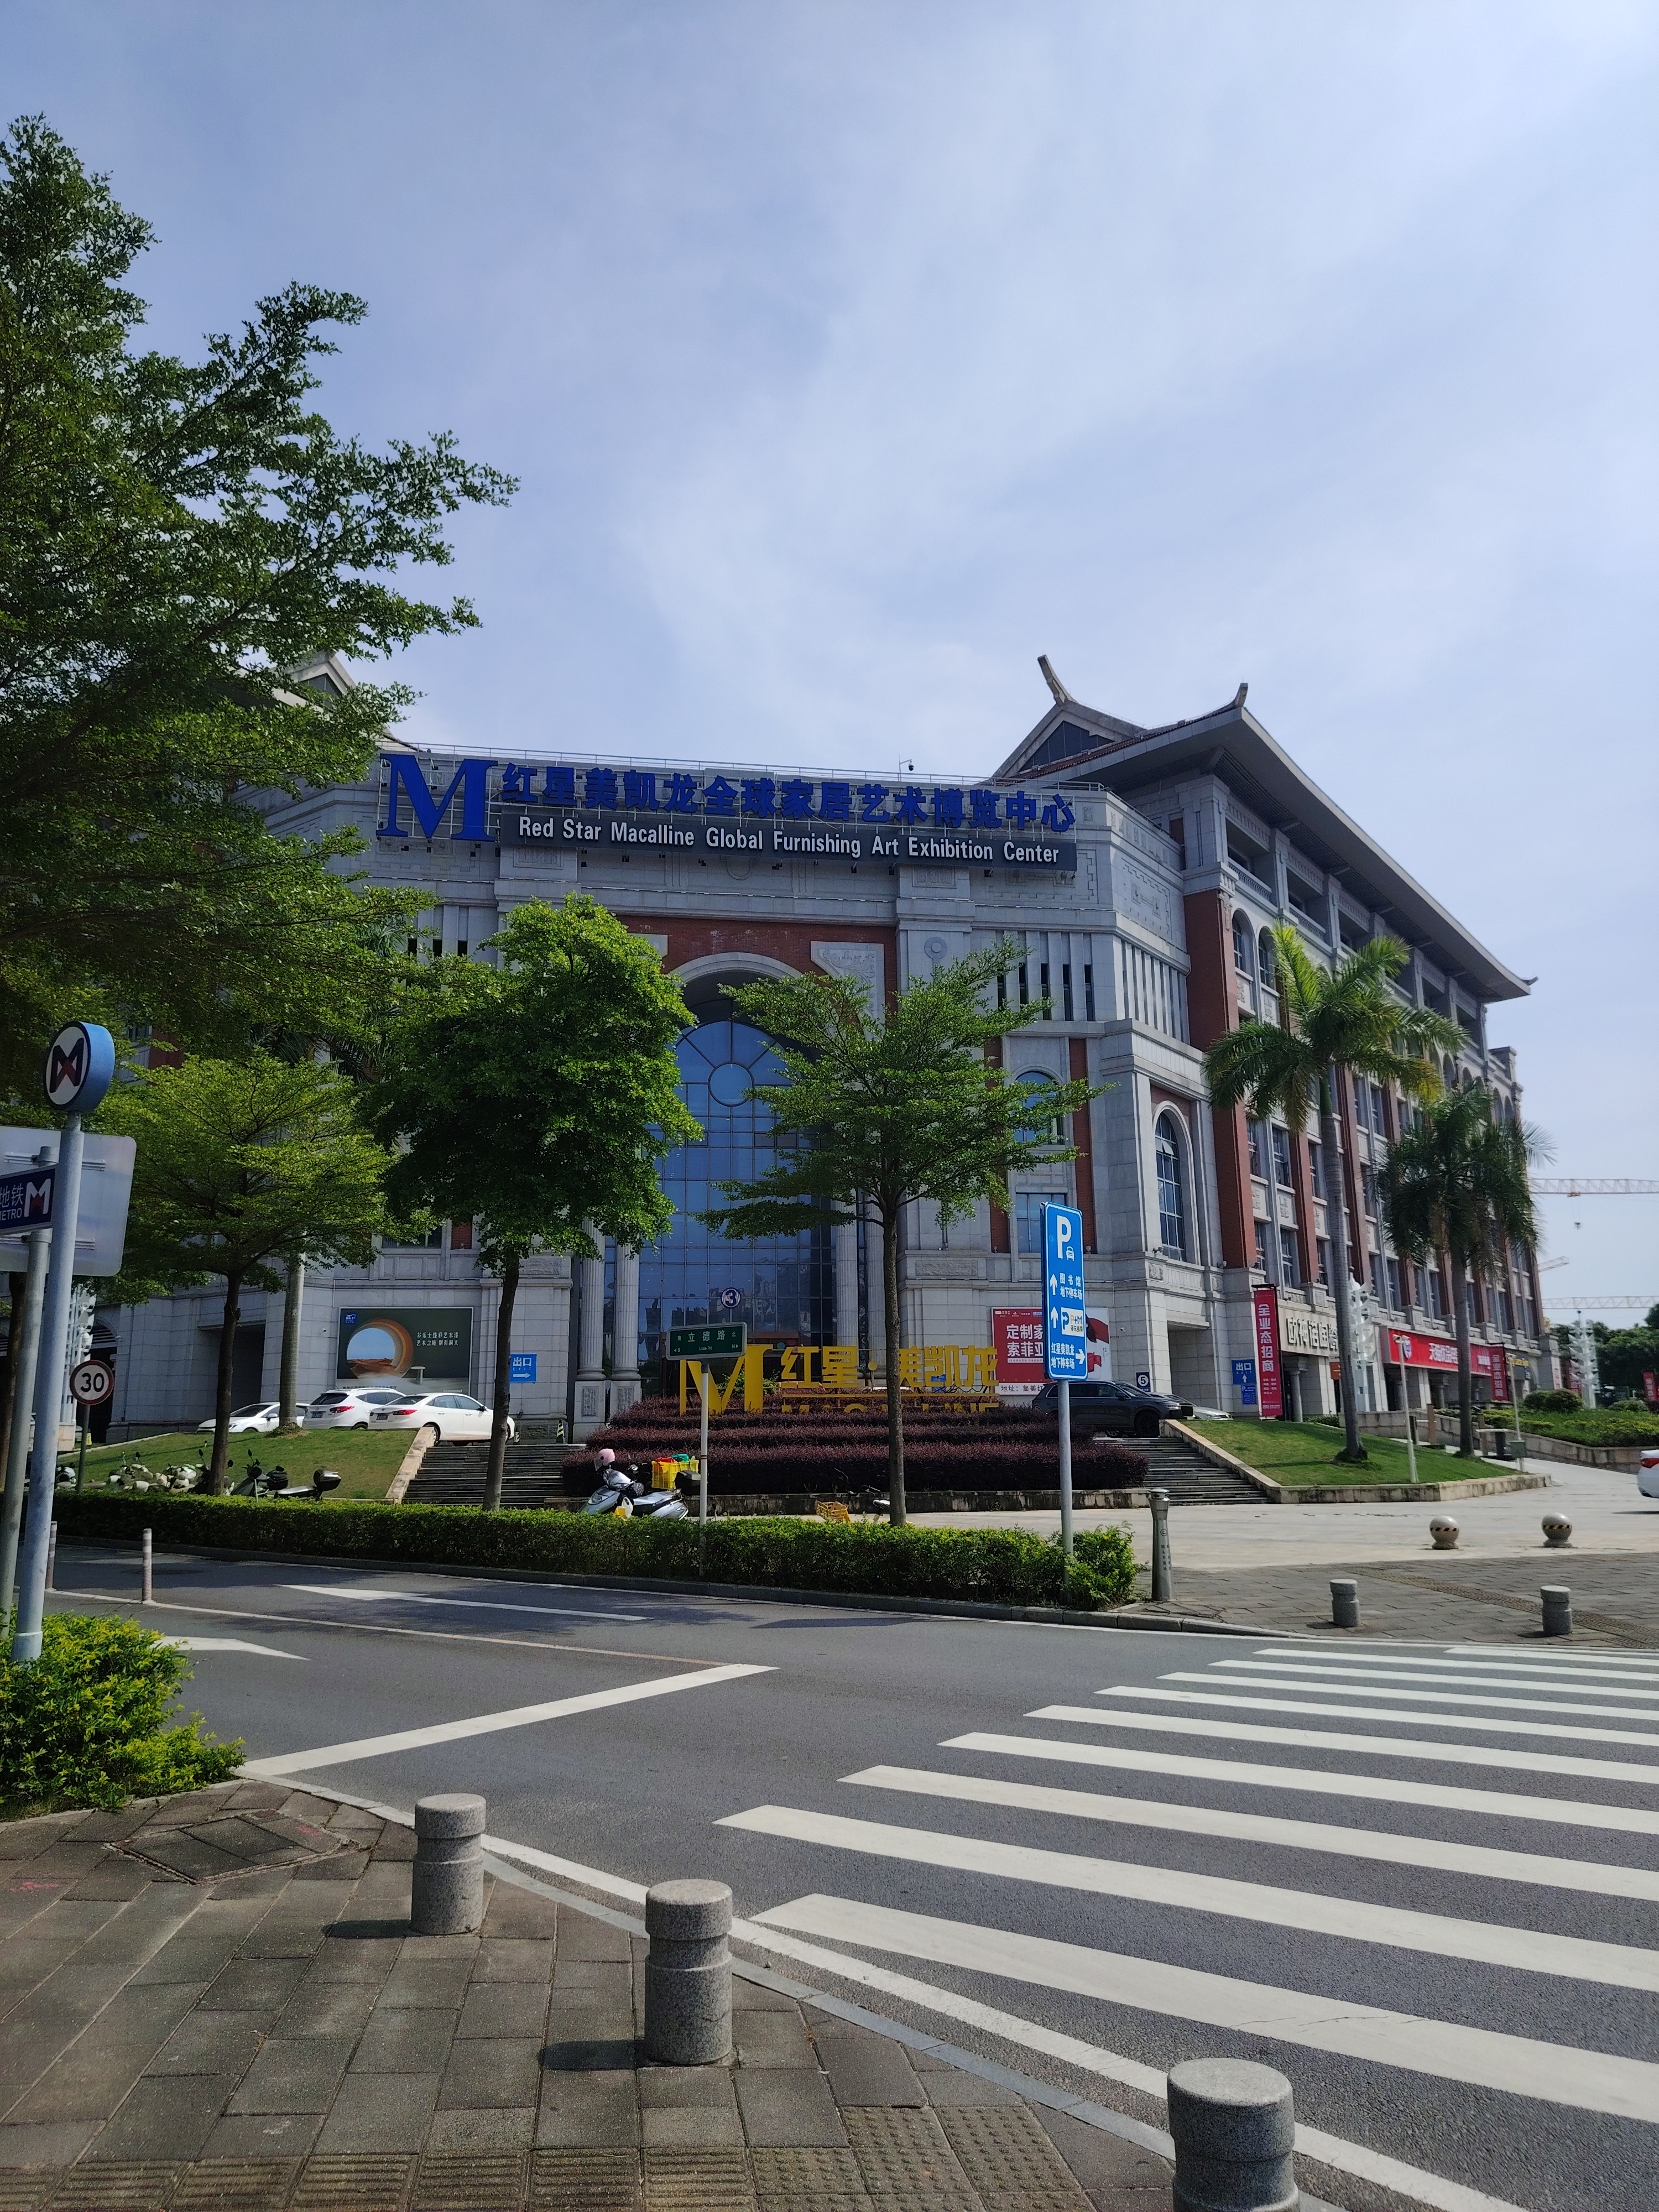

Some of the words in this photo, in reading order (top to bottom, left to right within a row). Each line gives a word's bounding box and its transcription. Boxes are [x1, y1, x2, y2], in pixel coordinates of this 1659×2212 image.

[376, 753, 498, 842] M
[501, 763, 1076, 832] 红星美凯龙全球家居艺术博览中心
[519, 816, 553, 838] Red
[562, 818, 602, 840] Star
[611, 822, 695, 846] Macalline
[706, 827, 763, 850] Global
[774, 831, 861, 858] Furnishing
[872, 836, 899, 856] Art
[909, 837, 994, 860] Exhibition
[1004, 841, 1060, 863] Center
[0, 1183, 24, 1208] 地铁
[1057, 1214, 1072, 1259] P
[1060, 1272, 1081, 1287] 图书馆
[725, 1290, 737, 1307] 3
[1060, 1286, 1082, 1300] 地下停车场
[687, 1329, 726, 1342] 立德路
[1006, 1323, 1043, 1340] 定制家
[1258, 1303, 1274, 1371] 全业态招商
[1051, 1342, 1074, 1356] 红星美凯龙
[513, 1357, 532, 1367] 出口
[1051, 1356, 1075, 1369] 地下停车场
[1235, 1362, 1251, 1371] 出口
[80, 1372, 105, 1392] 30
[1140, 1376, 1146, 1385] 5
